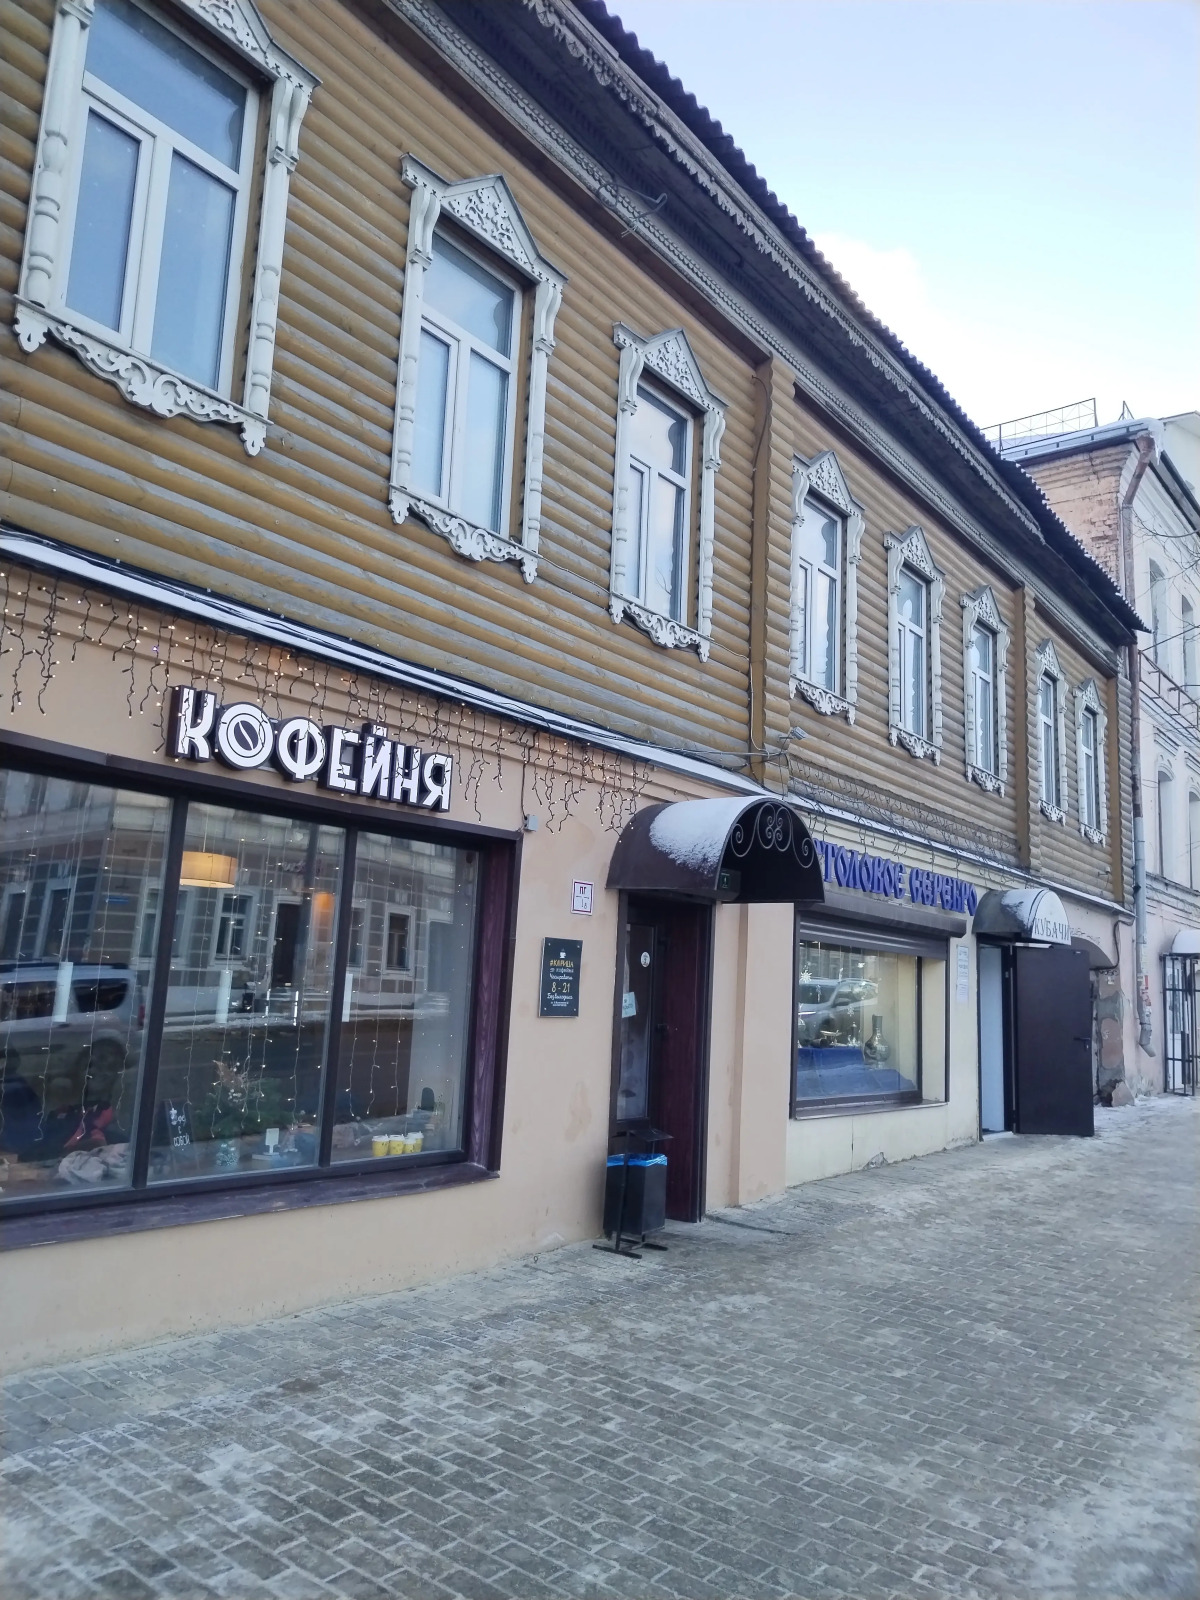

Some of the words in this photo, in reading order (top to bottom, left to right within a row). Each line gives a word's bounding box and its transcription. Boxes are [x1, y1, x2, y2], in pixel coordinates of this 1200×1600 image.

[168, 685, 454, 813] КОФЕЙНЯ
[909, 866, 978, 917] СЕРЕБРО
[1034, 917, 1070, 941] КУБАЧИ
[551, 981, 557, 993] 8
[562, 982, 571, 993] 21
